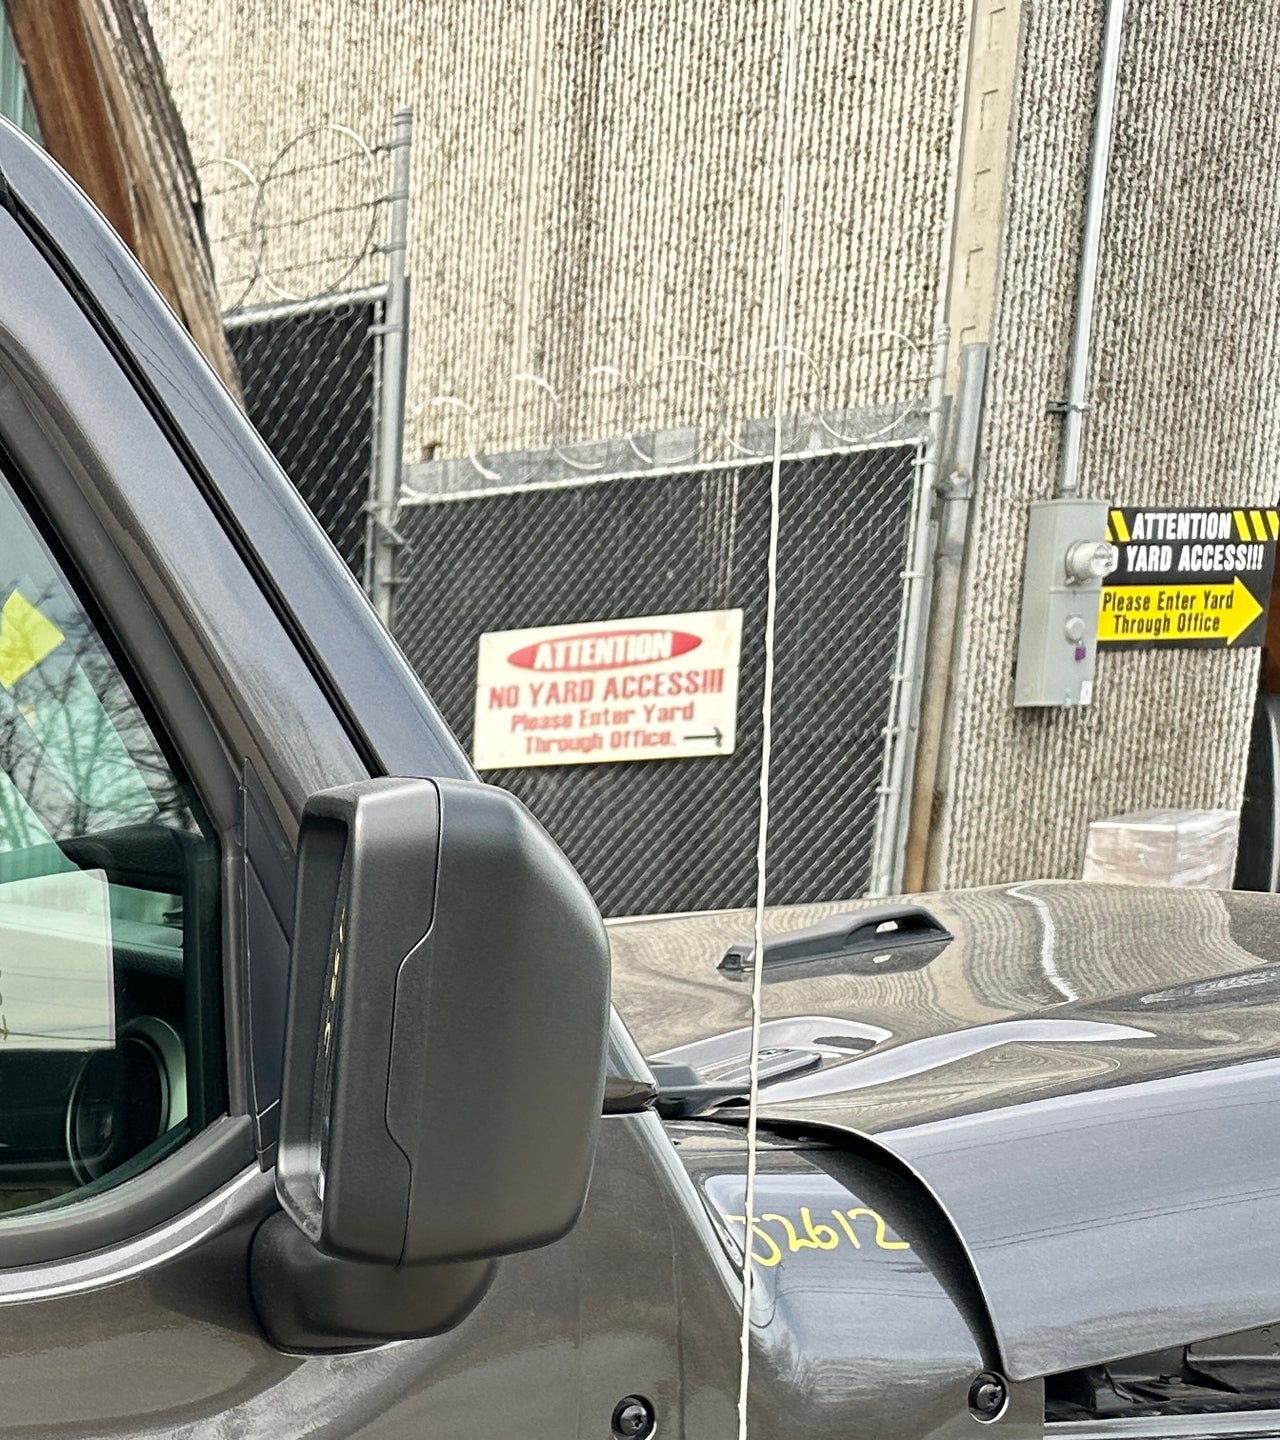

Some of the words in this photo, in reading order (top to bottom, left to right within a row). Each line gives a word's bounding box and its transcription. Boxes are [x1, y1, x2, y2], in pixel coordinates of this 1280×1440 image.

[1132, 512, 1232, 540] ATTENTION
[1126, 545, 1172, 572] YARD
[1178, 543, 1264, 571] ACCESS!!!
[1102, 591, 1151, 612] Please
[1157, 590, 1197, 611] Enter
[1203, 589, 1235, 610] Yard
[1113, 612, 1171, 636] Through
[1176, 612, 1221, 633] Office
[533, 631, 675, 670] ATTENTION
[489, 683, 520, 710] NO
[530, 679, 595, 707] YARD
[602, 668, 726, 702] ACCESS!!!
[511, 713, 573, 733] Please
[579, 708, 637, 729] Enter
[643, 701, 696, 724] Yard
[525, 732, 603, 755] Through
[724, 1206, 911, 1267] J2612
